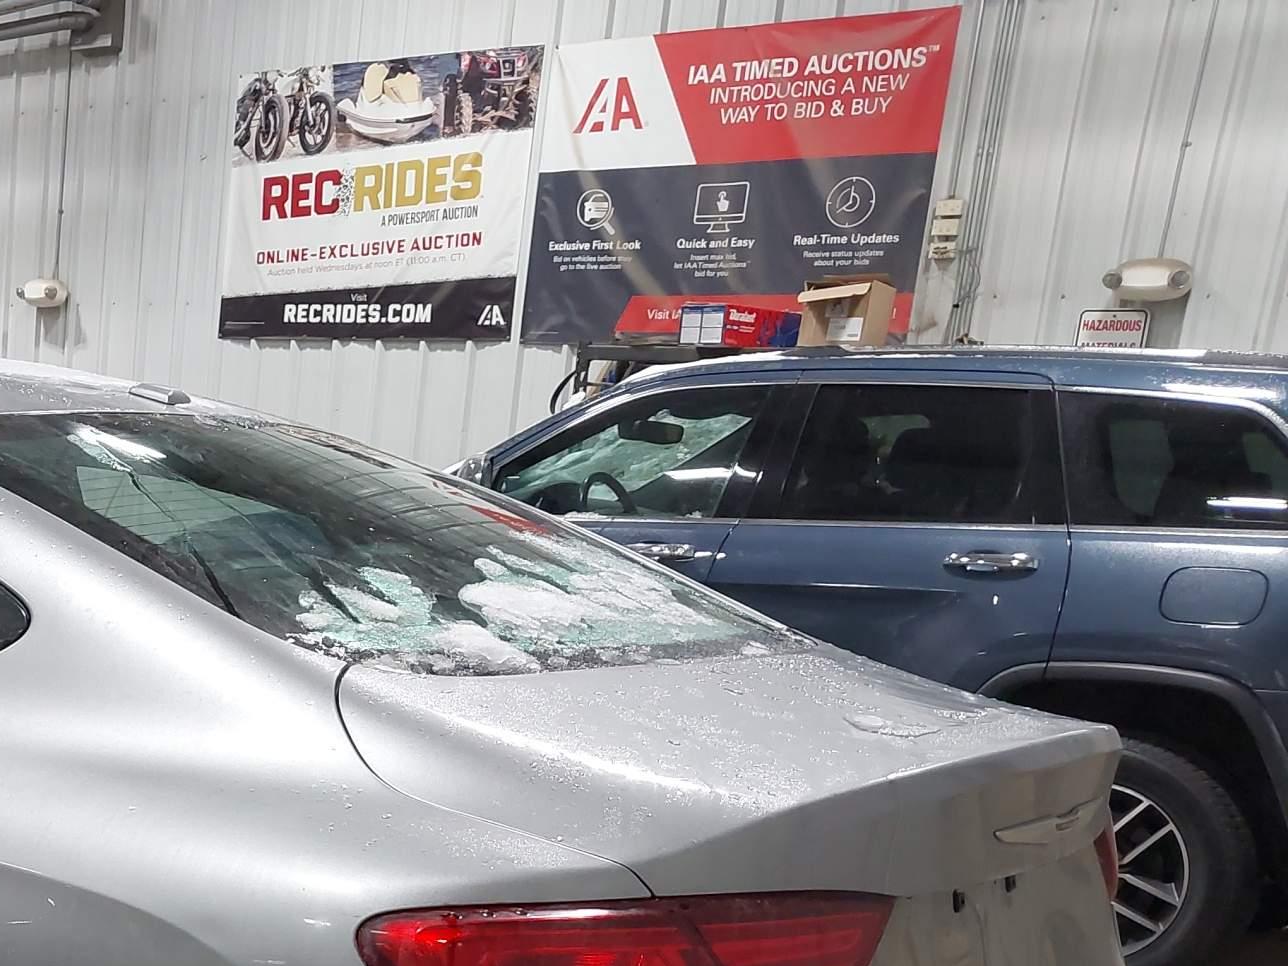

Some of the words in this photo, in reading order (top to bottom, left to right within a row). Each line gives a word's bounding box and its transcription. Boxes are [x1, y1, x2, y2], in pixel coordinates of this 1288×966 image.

[688, 64, 727, 85] IAA
[732, 57, 799, 82] TIMED
[710, 78, 836, 105] INTRODUCING
[840, 77, 856, 95] A
[862, 73, 910, 93] NEW
[720, 105, 760, 124] WAY
[764, 102, 787, 121] TO
[793, 101, 825, 119] BID
[830, 99, 844, 117] &
[851, 96, 892, 115] BUY
[261, 168, 344, 221] REC
[352, 151, 483, 213] RIDES
[380, 215, 387, 227] A
[387, 209, 441, 226] POWERSPORT
[442, 205, 479, 221] AUCTION
[548, 239, 590, 251] Exclusive
[592, 239, 614, 250] First
[616, 239, 642, 250] Look
[676, 238, 707, 249] Quick
[709, 238, 729, 249] and
[730, 237, 756, 249] Easy
[793, 234, 848, 246] Real-Time
[851, 233, 900, 246] Updates
[256, 238, 406, 265] ONLINE-EXCLUSIVE
[410, 232, 483, 251] AUCTION
[802, 250, 829, 258] Receive
[854, 249, 884, 258] updates
[267, 268, 296, 277] Auction
[350, 293, 368, 301] Visit
[283, 303, 433, 323] RECRIDES.COM
[647, 309, 669, 320] Visit
[1082, 319, 1143, 331] HAZARDOUS
